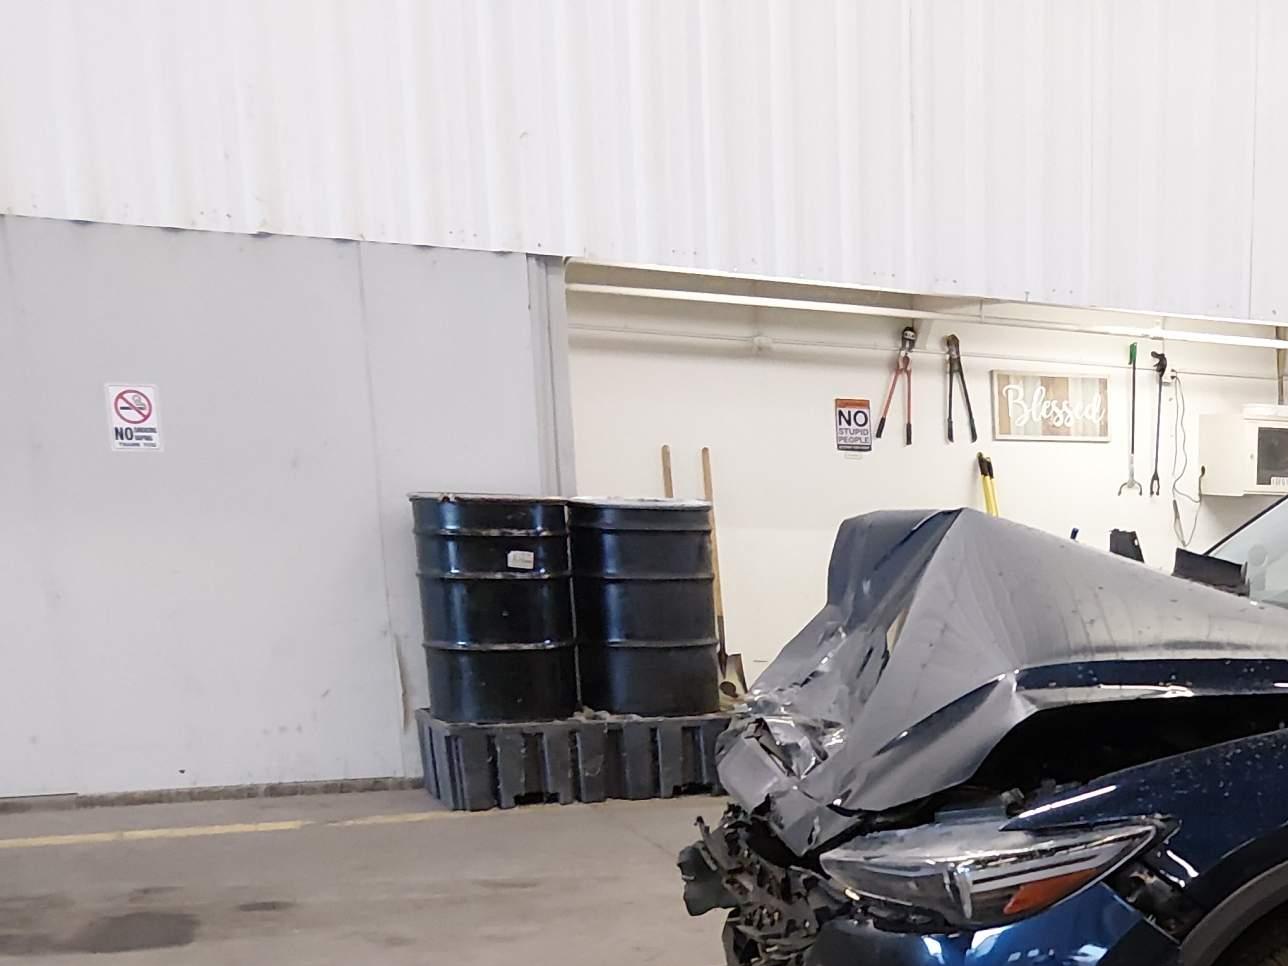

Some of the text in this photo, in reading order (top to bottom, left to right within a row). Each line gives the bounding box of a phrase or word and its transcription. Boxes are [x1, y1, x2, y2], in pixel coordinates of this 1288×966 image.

[1002, 384, 1106, 427] Blessed
[838, 410, 869, 427] NO
[114, 427, 134, 441] NO
[838, 428, 869, 436] STUPID
